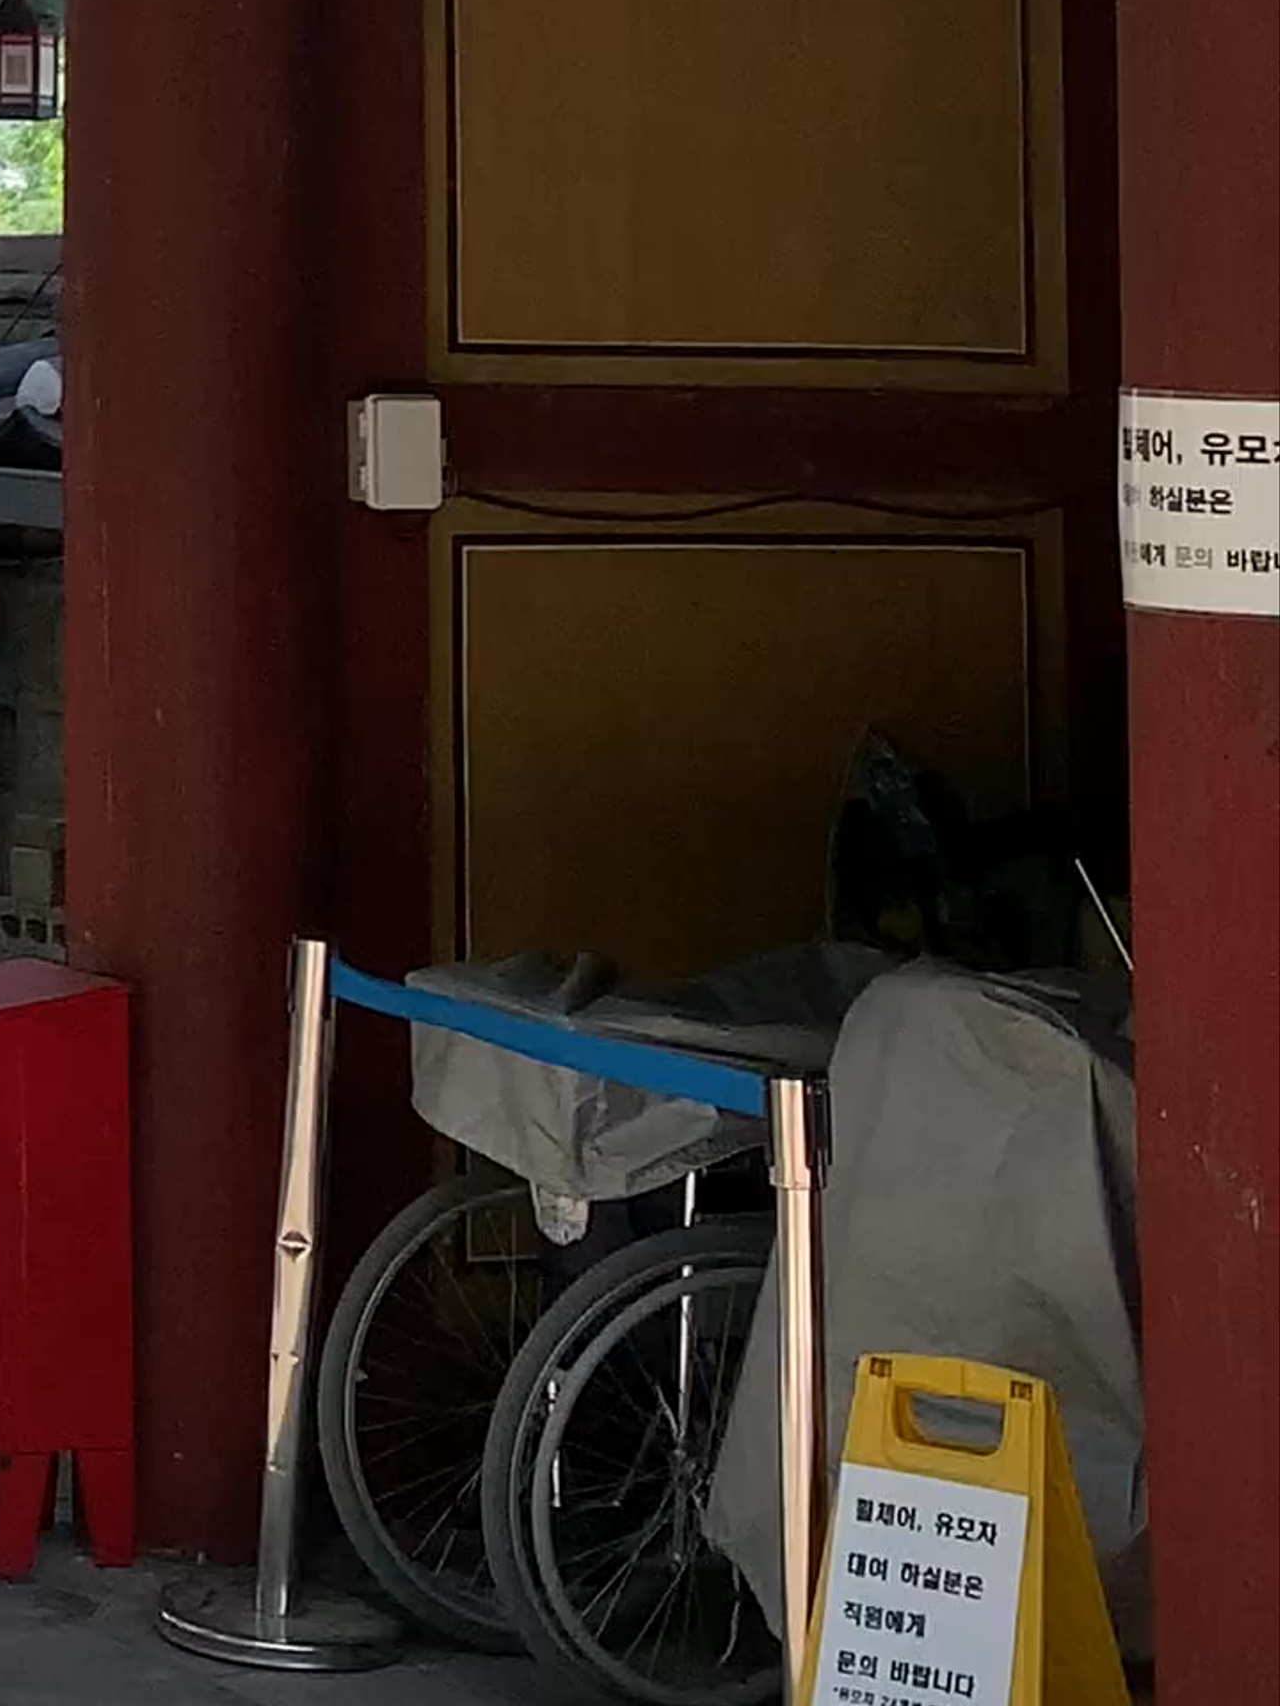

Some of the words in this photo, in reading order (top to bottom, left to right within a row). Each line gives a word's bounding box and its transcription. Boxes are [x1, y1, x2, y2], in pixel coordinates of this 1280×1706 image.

[1200, 433, 1280, 467] 유모
[1149, 485, 1233, 514] 하실분은
[1175, 546, 1213, 569] 문의
[847, 1552, 888, 1581] 대여
[900, 1561, 984, 1600] 하실분은
[843, 1600, 926, 1638] 직원에게
[837, 1650, 878, 1679] 문의
[890, 1659, 976, 1698] 바랍니다
